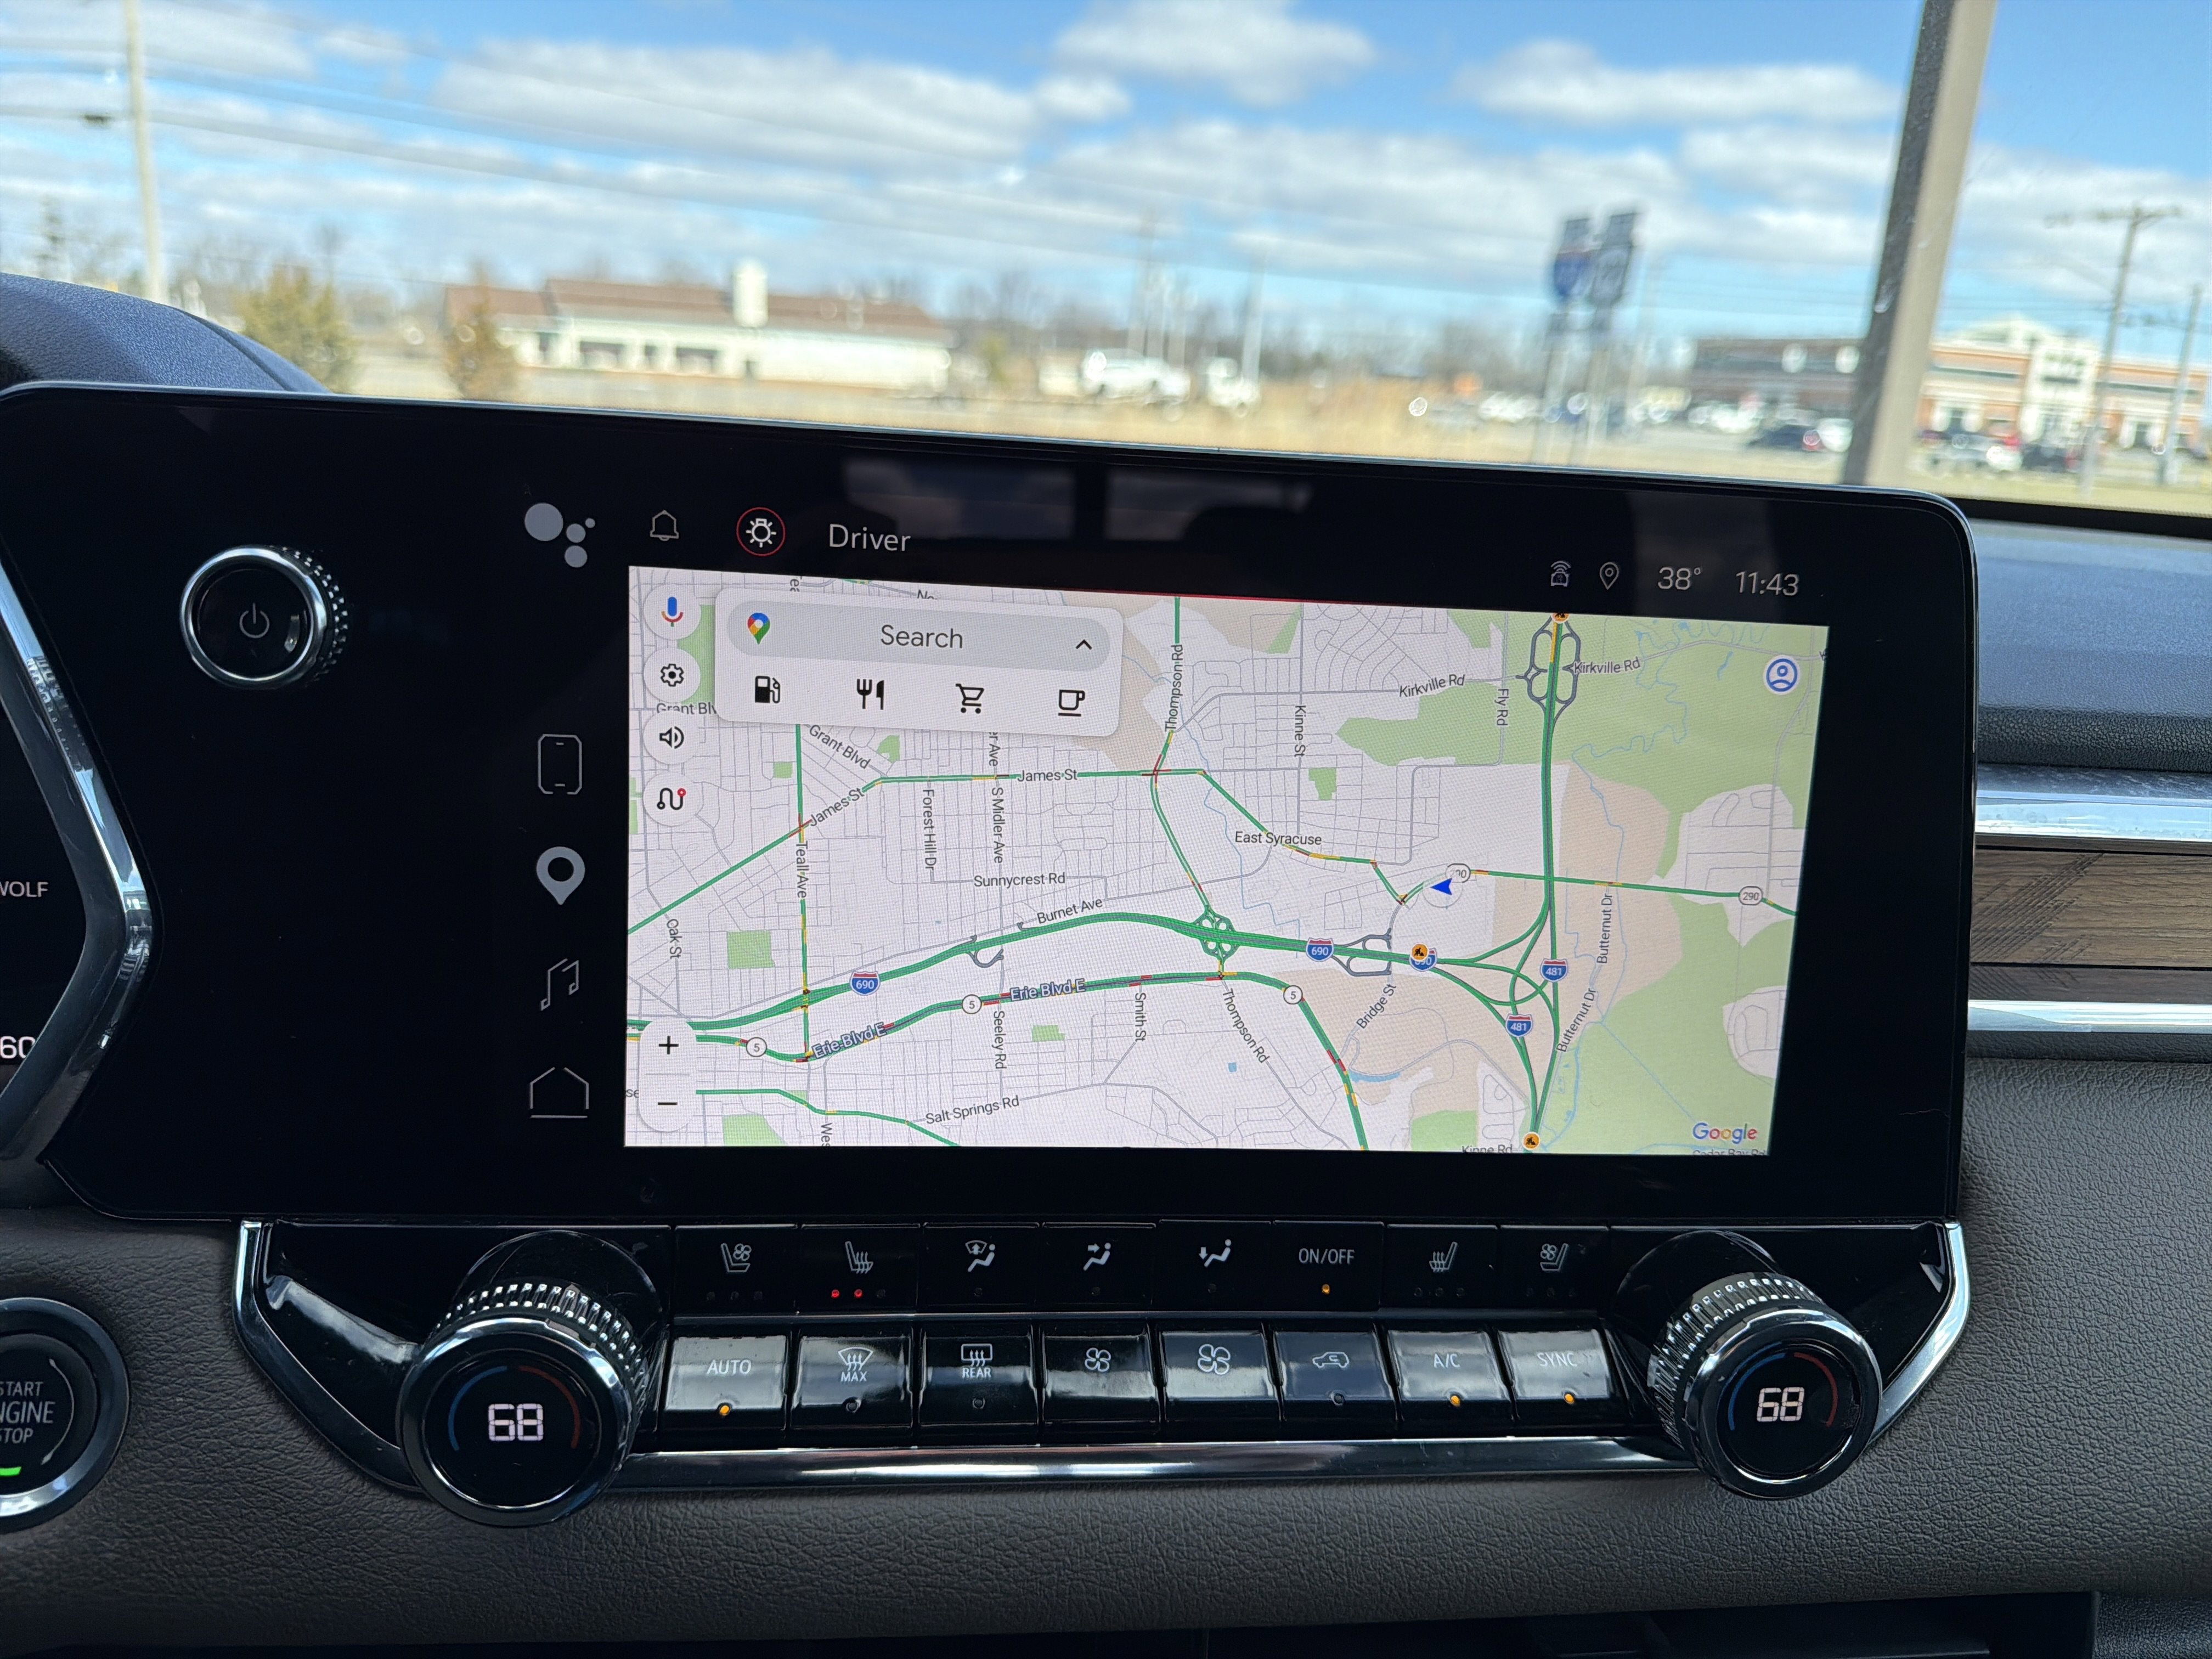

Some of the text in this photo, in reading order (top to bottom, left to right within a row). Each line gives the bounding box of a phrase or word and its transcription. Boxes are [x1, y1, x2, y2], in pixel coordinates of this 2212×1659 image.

[829, 523, 910, 551] Driver
[1657, 566, 1701, 590] 38°
[1735, 571, 1799, 596] 11:43
[880, 624, 963, 649] Search
[1574, 657, 1640, 675] Kirkville Rd
[1165, 645, 1183, 731] Thompson Rd
[1399, 674, 1465, 698] Kirkville Rd
[1496, 689, 1509, 726] Fly Rd
[1294, 705, 1306, 757] Kinne St
[809, 724, 871, 770] Grant Blvd
[989, 743, 1001, 766] Ave
[1017, 769, 1077, 782] James St
[810, 788, 865, 827] James St
[922, 789, 936, 871] Forest Hill Dr
[992, 787, 1006, 864] S Midler Ave
[1235, 831, 1322, 847] East Syracuse
[795, 843, 809, 899] Teall Ave
[974, 872, 1065, 889] Sunnycrest Rd
[1743, 892, 1759, 901] 290
[1037, 898, 1103, 924] Burnet Ave
[666, 918, 682, 958] Oak St
[1596, 893, 1612, 963] Butternut Dr
[1311, 946, 1329, 956] 690
[1545, 967, 1562, 976] 481
[855, 979, 874, 989] 690
[1010, 978, 1086, 1001] Erie Blvd E
[1290, 991, 1296, 1000] 5
[969, 1000, 975, 1009] 5
[1135, 992, 1147, 1041] Smith St
[1356, 983, 1397, 1029] Bridge St
[1222, 989, 1269, 1064] Thompson Rd
[1510, 1022, 1527, 1031] 481
[1557, 988, 1596, 1052] Butternut Dr
[754, 1043, 760, 1052] 5
[811, 1022, 885, 1059] Erie Blvd E
[992, 1011, 1006, 1069] Seeley Rd
[925, 1095, 1019, 1125] Salt Springs Rd
[1692, 1121, 1758, 1144] Google
[1299, 1248, 1355, 1266] ON/OFF
[707, 1359, 752, 1375] AUTO
[1433, 1352, 1461, 1369] A/C
[1537, 1351, 1578, 1368] SYNC
[840, 1371, 867, 1383] MAX
[962, 1367, 992, 1379] REAR
[1756, 1386, 1805, 1422] 68
[488, 1403, 544, 1442] 68
